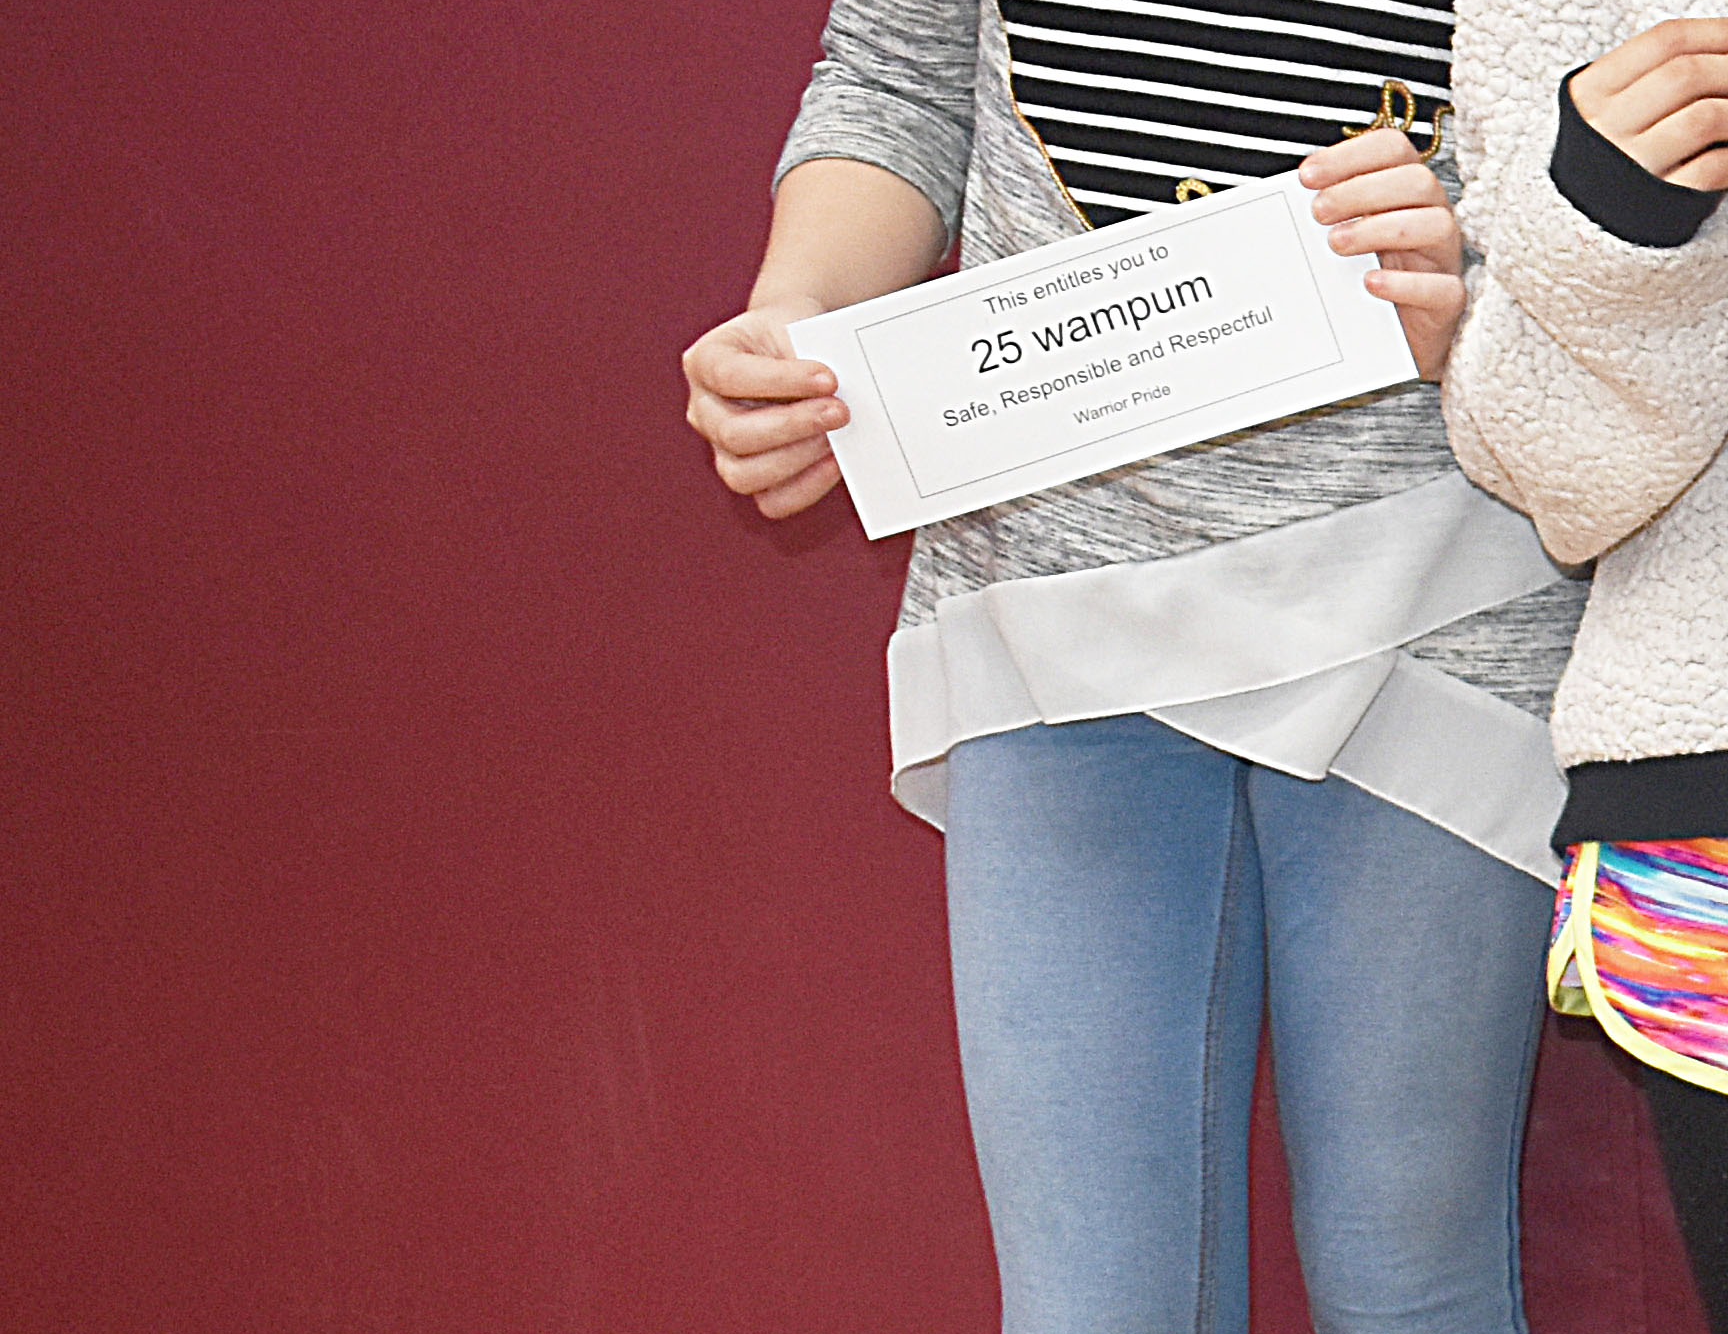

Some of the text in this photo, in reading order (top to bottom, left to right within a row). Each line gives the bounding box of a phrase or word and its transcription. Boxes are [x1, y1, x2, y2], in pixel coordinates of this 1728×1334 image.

[982, 245, 1169, 315] This entitles you to
[942, 305, 1273, 427] Safe, Responsible and Respectful
[971, 275, 1213, 374] 25 wampum
[1072, 385, 1171, 425] Warrior Pride
